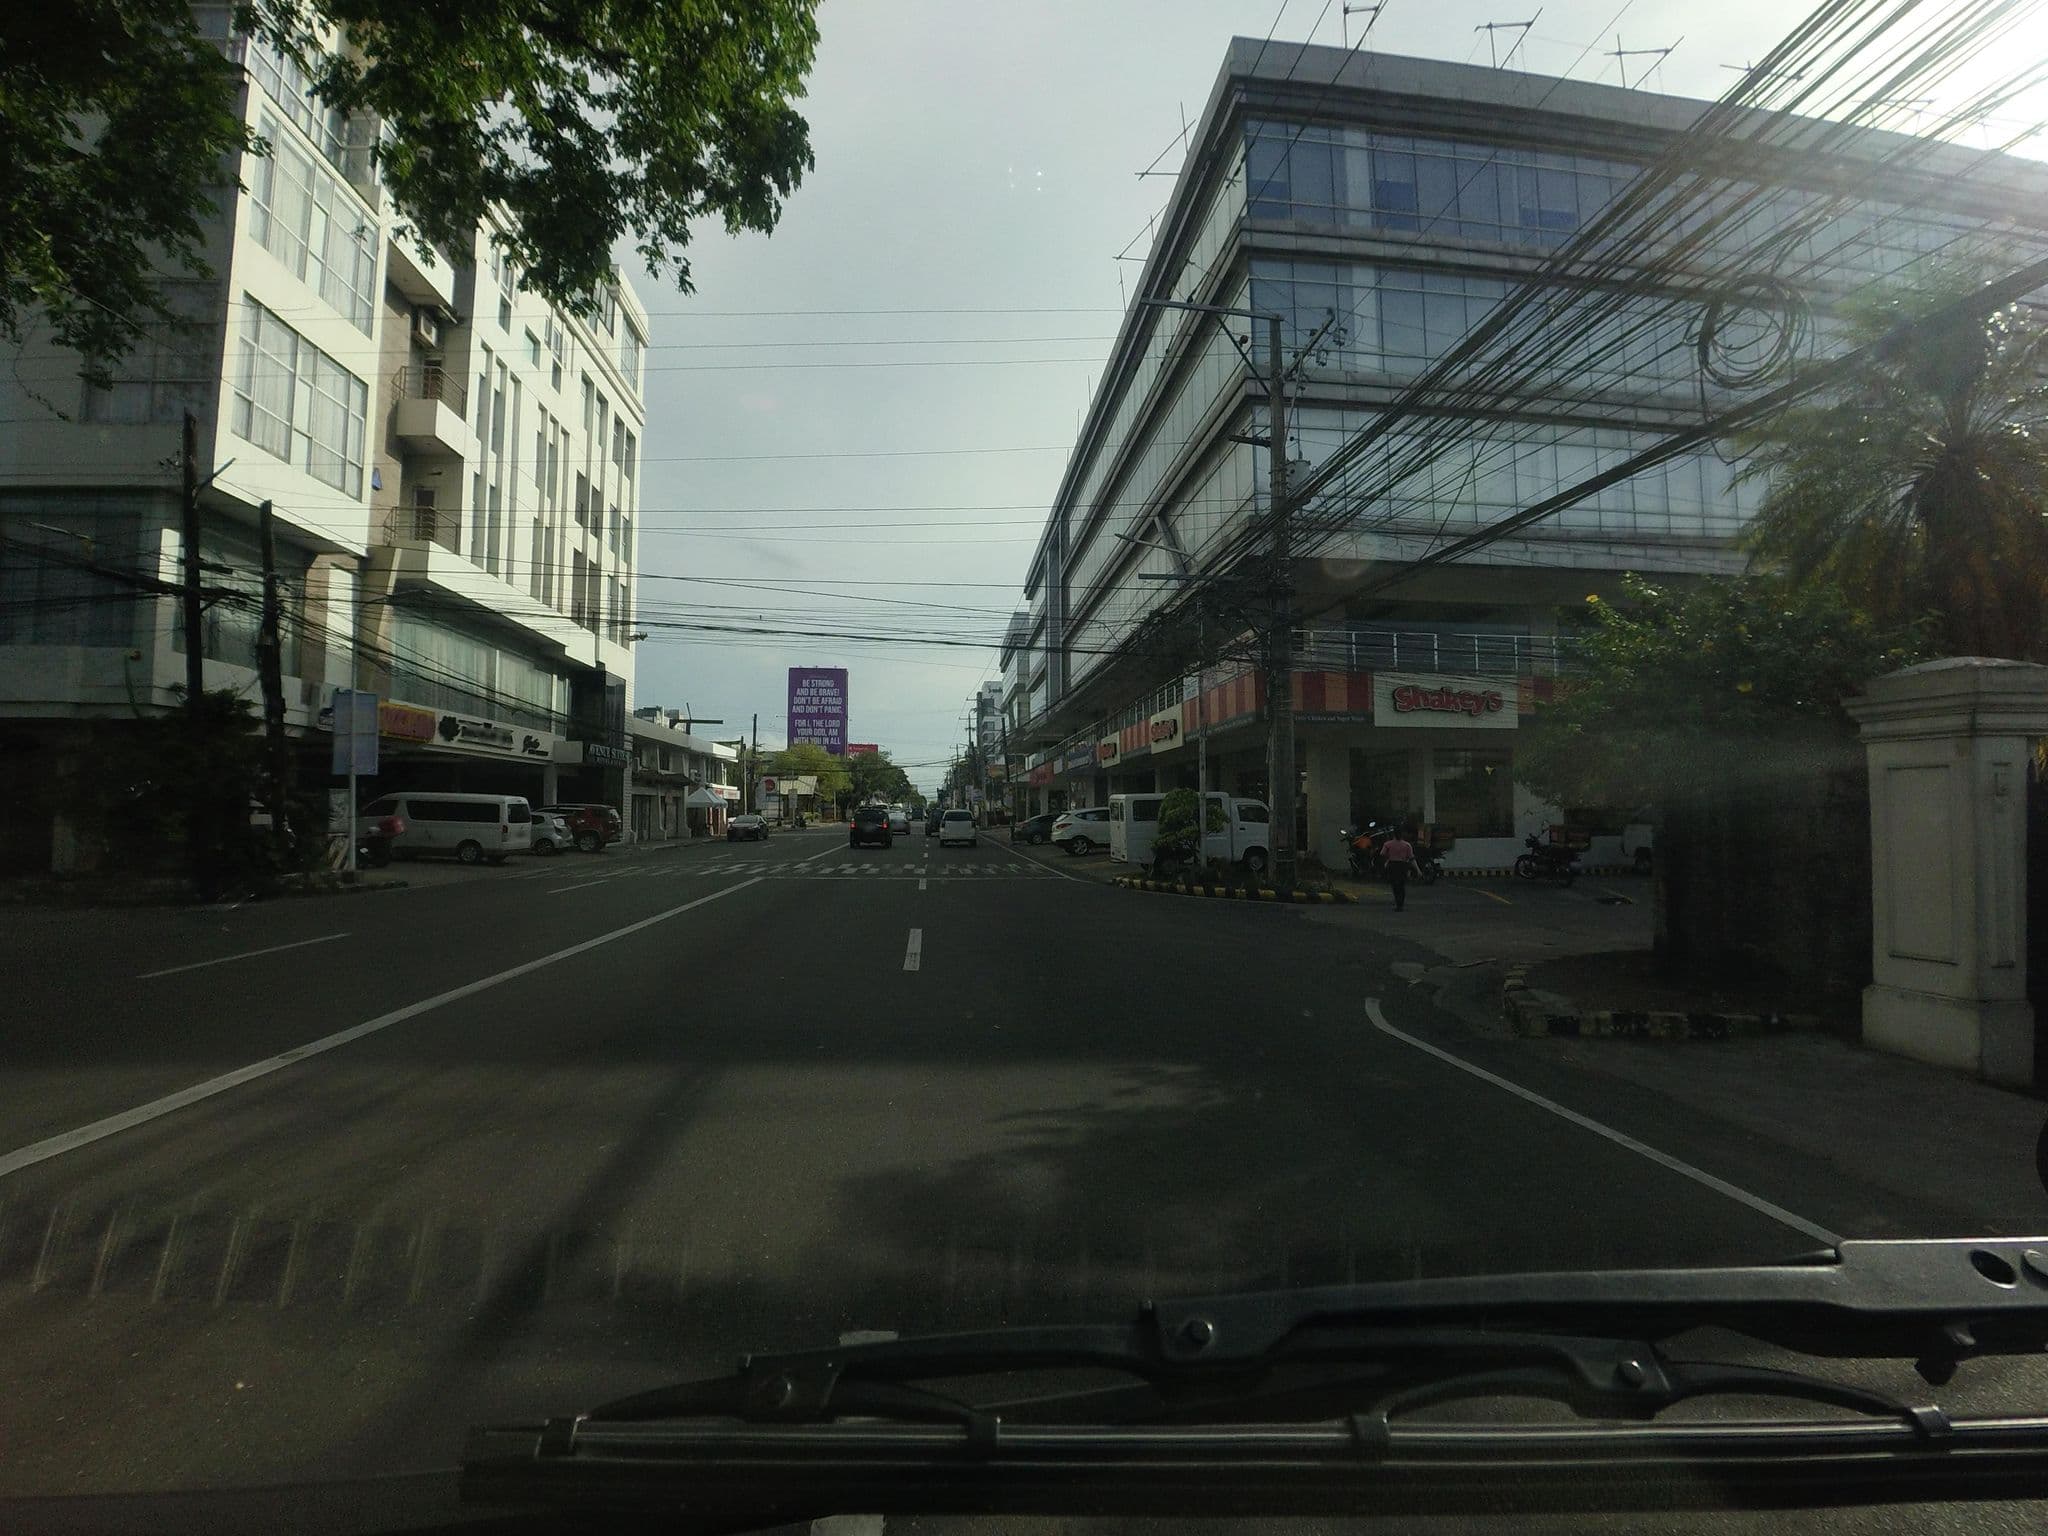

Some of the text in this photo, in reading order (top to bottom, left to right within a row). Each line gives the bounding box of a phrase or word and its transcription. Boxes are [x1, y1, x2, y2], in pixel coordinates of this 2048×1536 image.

[802, 679, 835, 687] BE STRONG
[796, 687, 809, 696] AND
[809, 687, 818, 696] BE
[793, 696, 843, 705] DON'T BE AFRAID
[1392, 685, 1505, 716] Shakey's
[791, 705, 805, 714] AND
[805, 705, 823, 714] DON'T
[794, 719, 807, 728] FOR
[812, 719, 824, 728] THE
[824, 719, 841, 728] LORD
[796, 728, 813, 736] YOUR
[828, 728, 838, 736] AM
[793, 737, 841, 745] WITH YOU IN ALL
